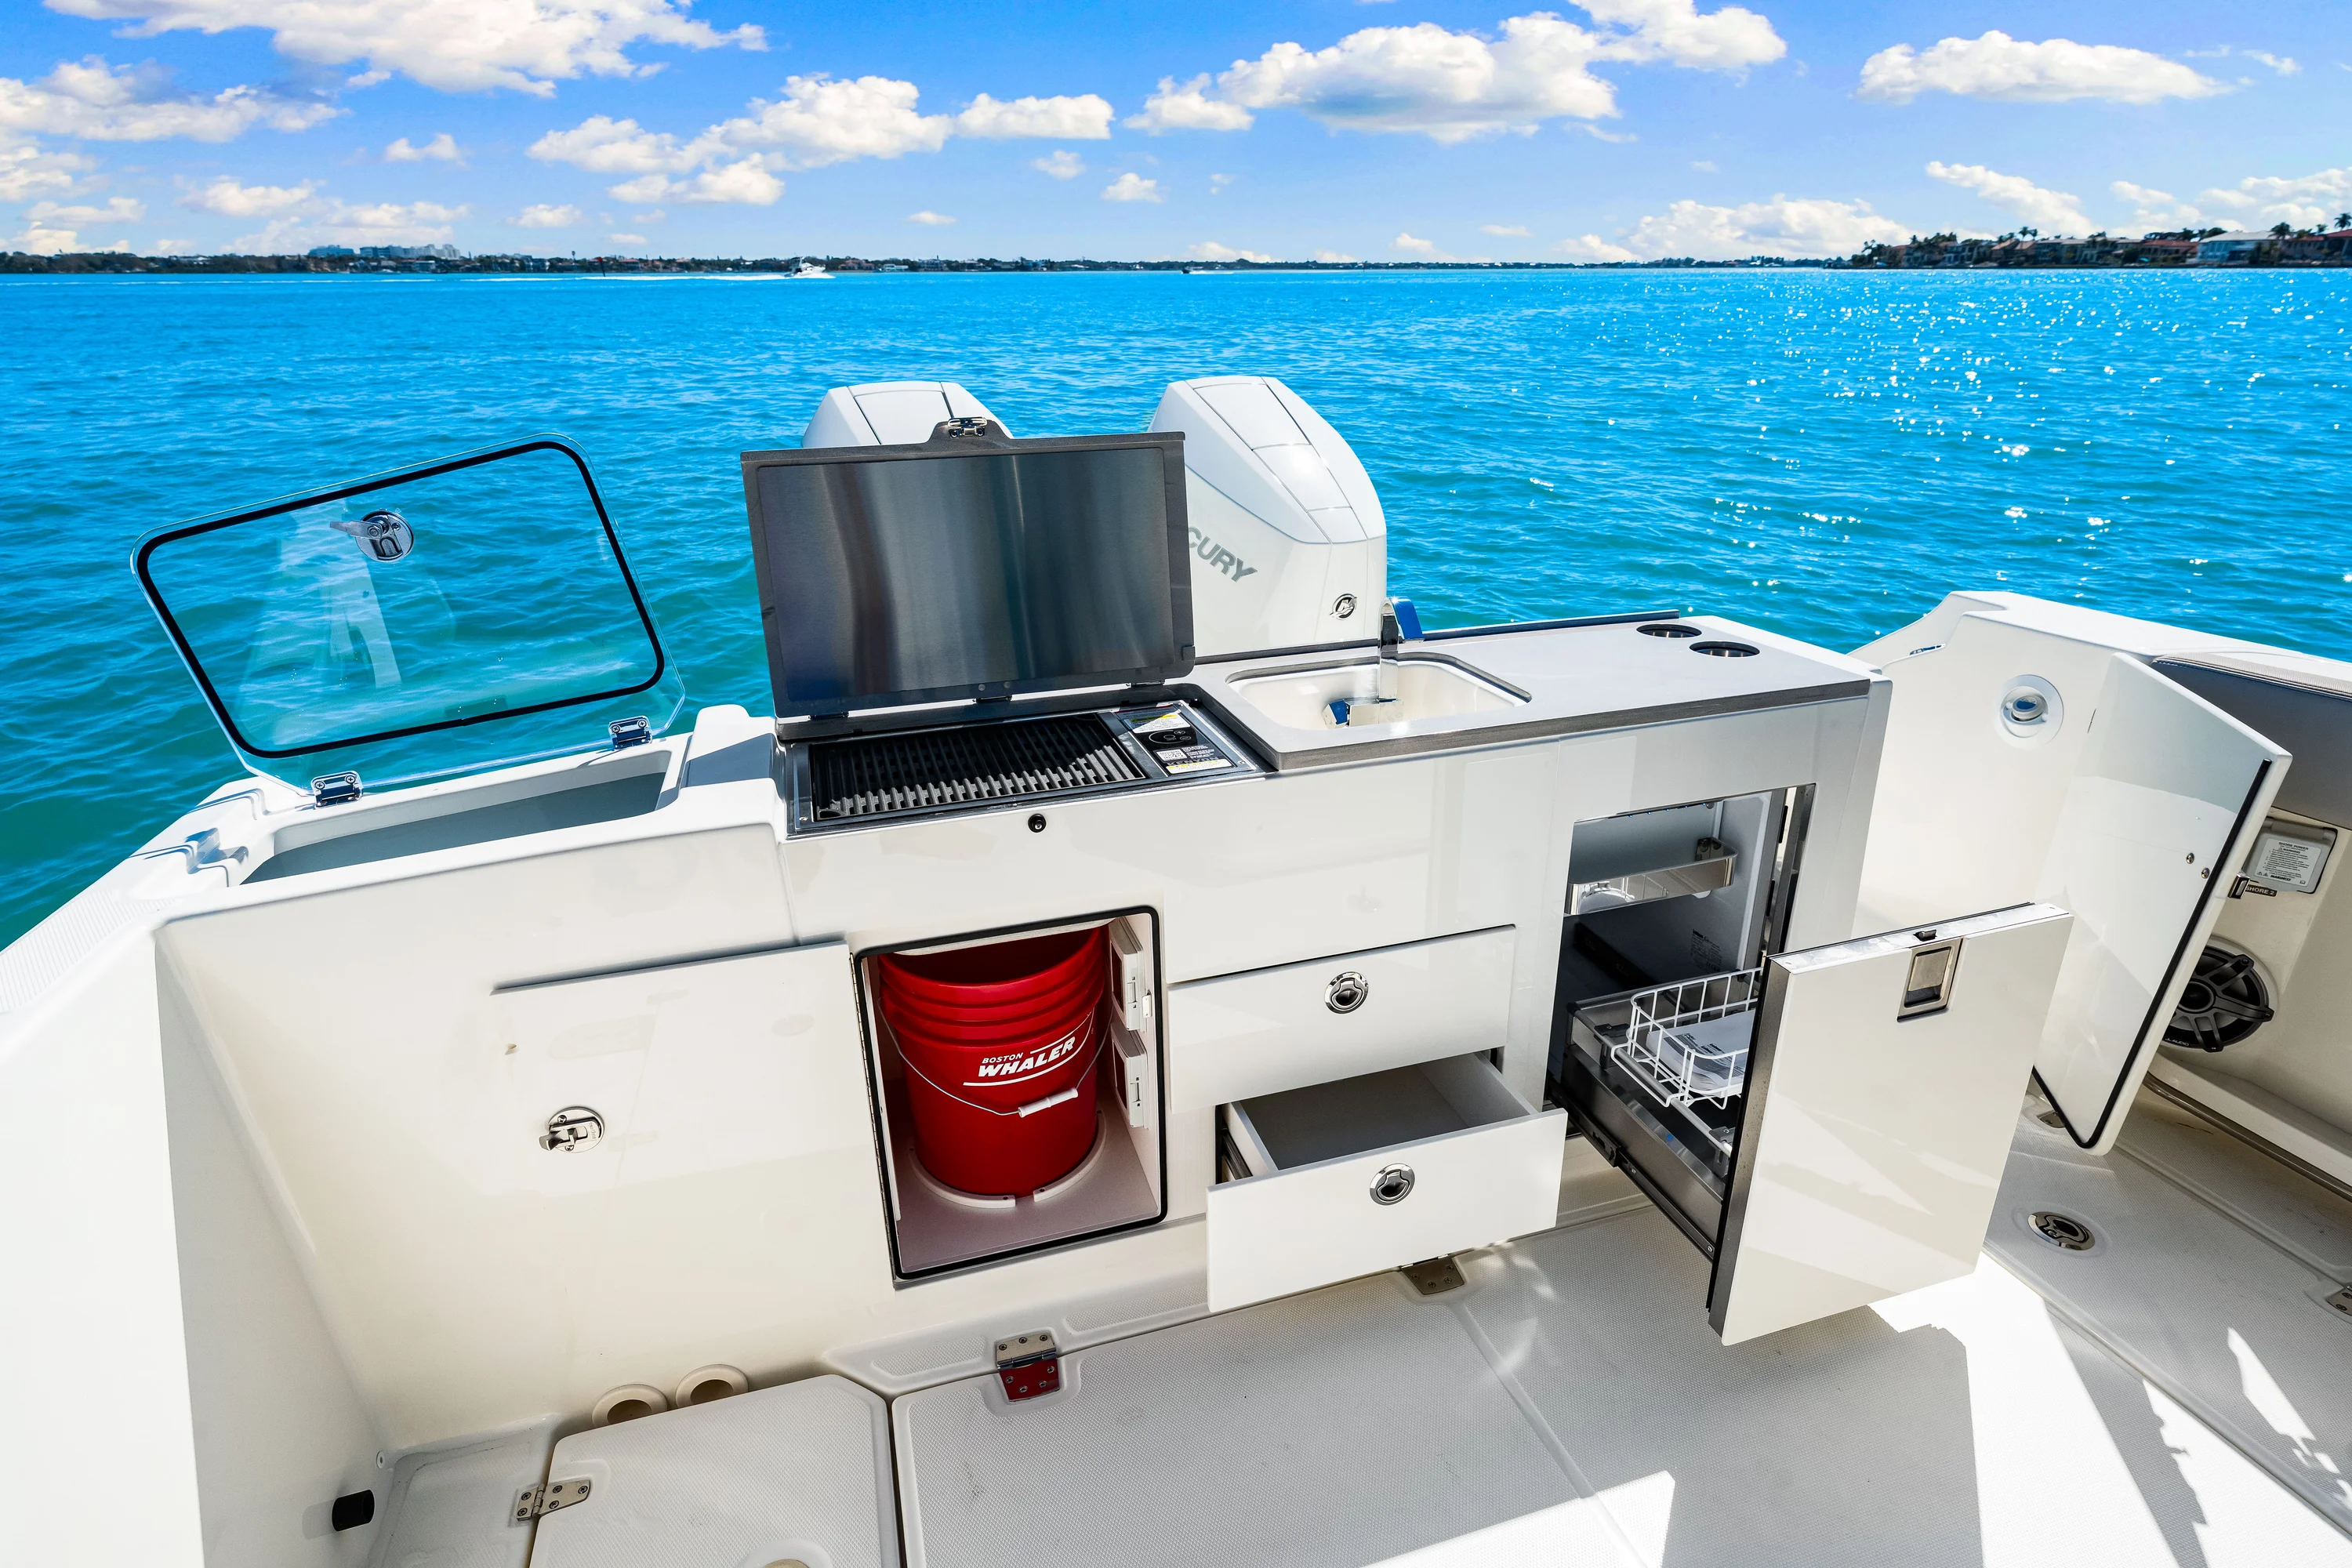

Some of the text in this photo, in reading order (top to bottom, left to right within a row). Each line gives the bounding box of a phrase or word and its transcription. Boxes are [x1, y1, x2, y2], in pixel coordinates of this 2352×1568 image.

[1189, 525, 1258, 583] CURY
[978, 1036, 1076, 1077] WHALER
[982, 1052, 1024, 1064] BOSTON
